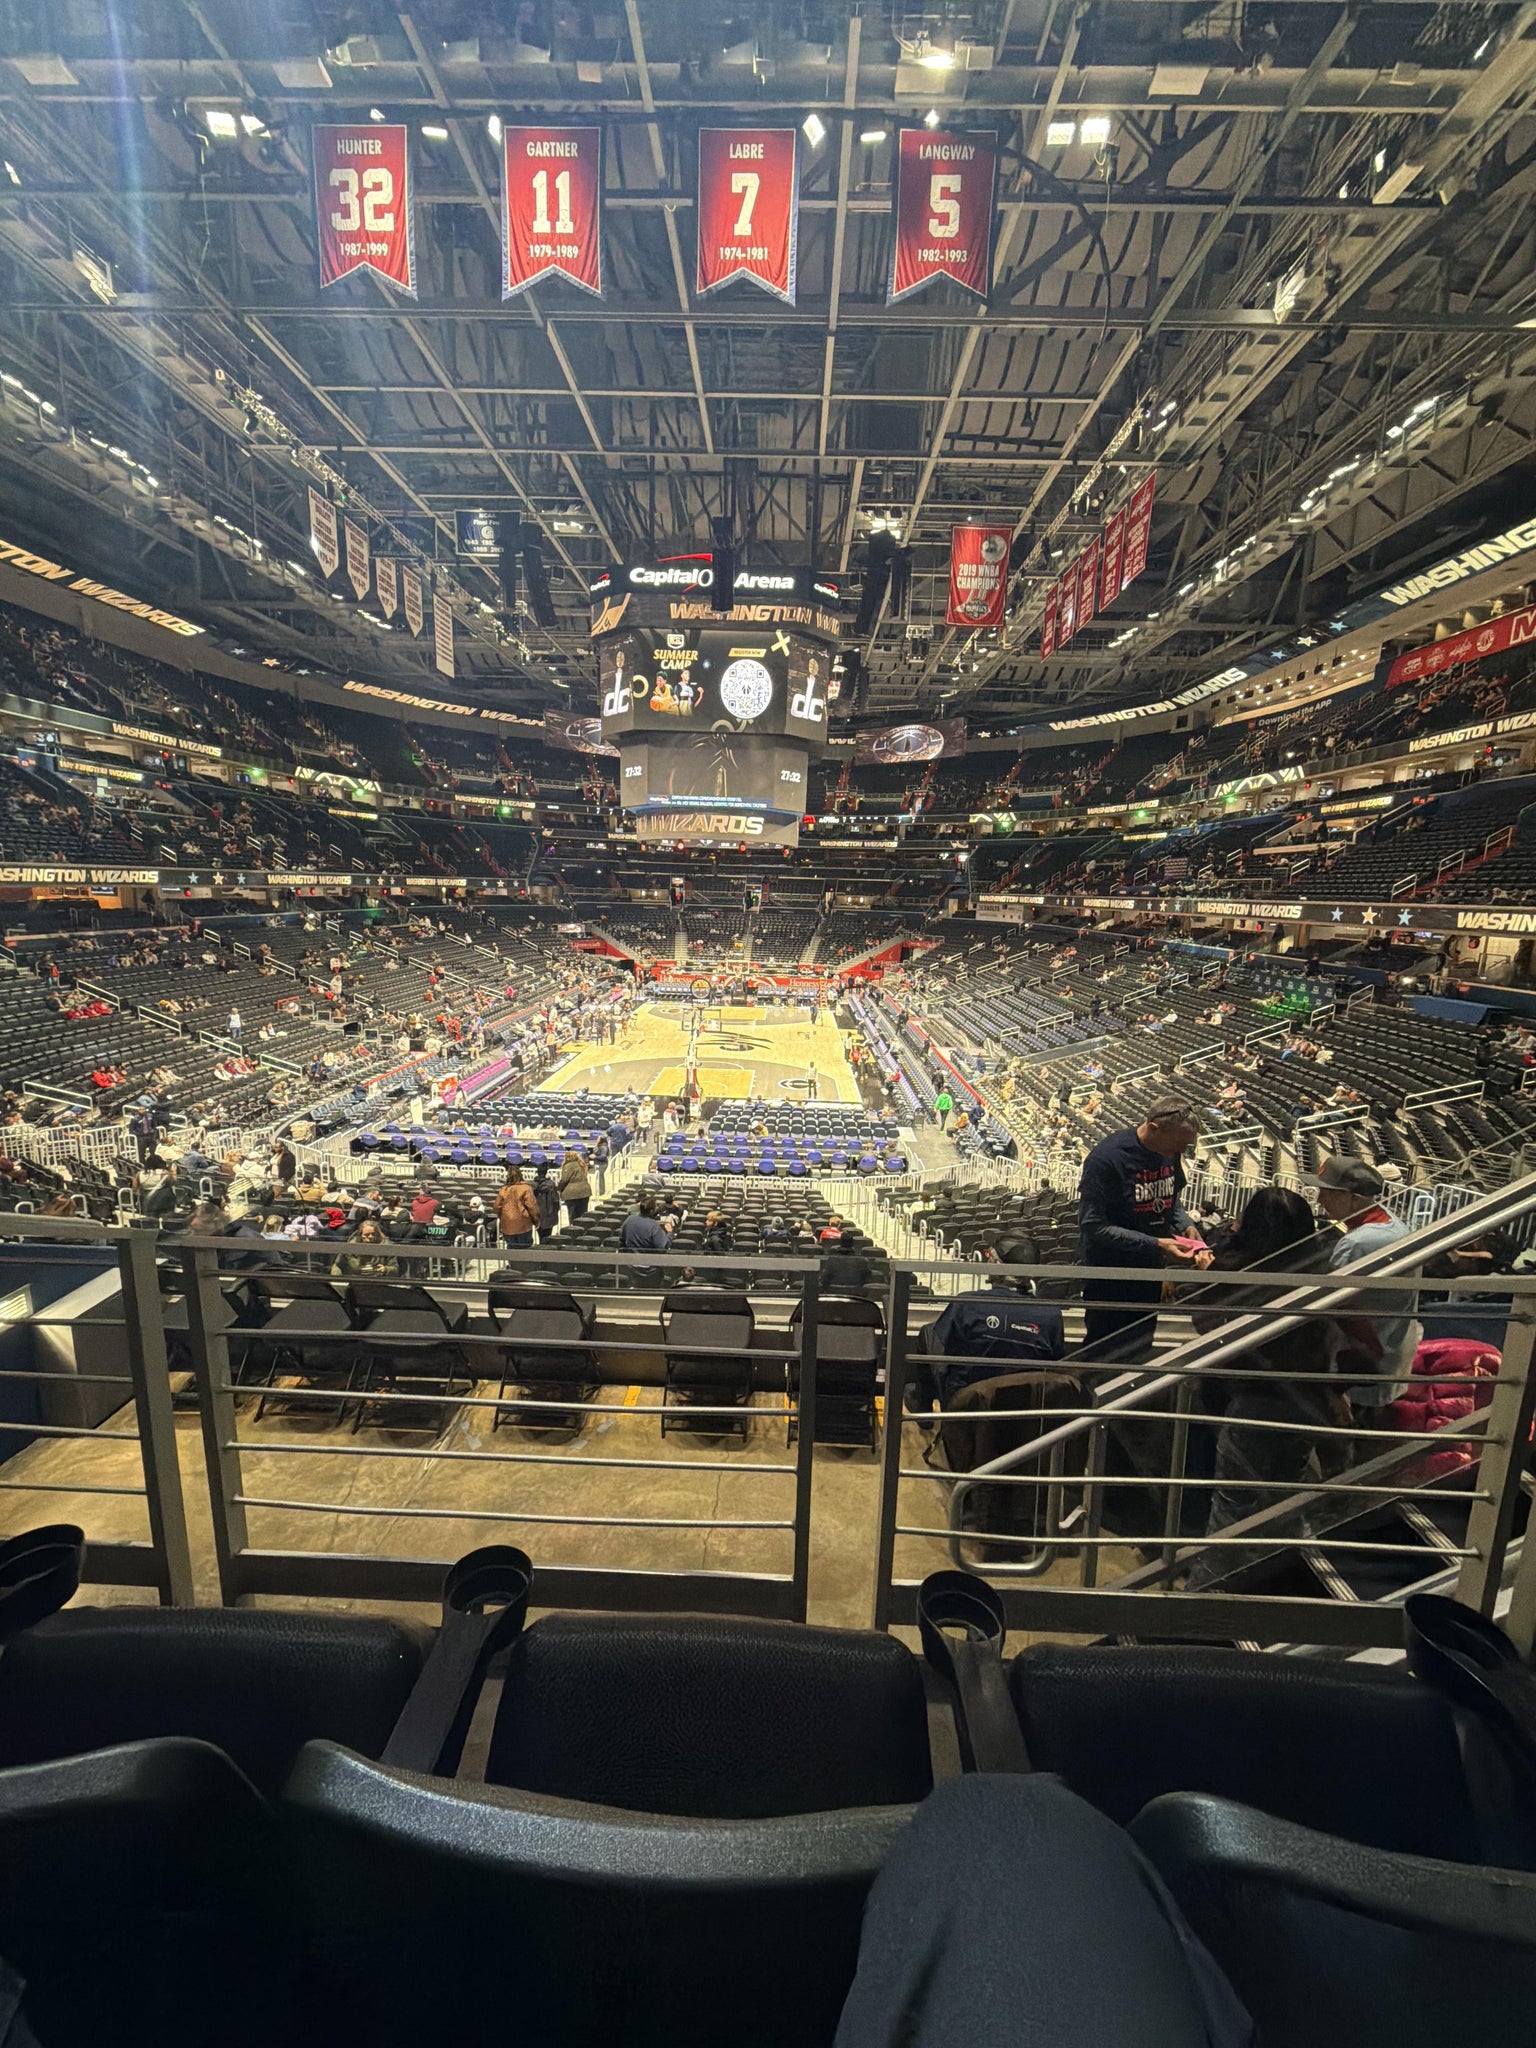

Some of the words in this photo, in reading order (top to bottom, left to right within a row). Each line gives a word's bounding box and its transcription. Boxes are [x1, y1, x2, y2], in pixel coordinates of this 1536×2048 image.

[337, 138, 382, 157] HUNTER
[526, 140, 579, 159] GARTNER
[728, 142, 765, 161] LABRE
[918, 143, 976, 161] LANGWAY
[329, 168, 394, 233] 32
[532, 170, 574, 235] 11
[731, 172, 760, 237] 7
[928, 174, 961, 238] 5
[339, 242, 389, 259] 1987-1999
[529, 243, 580, 261] 1979-1989
[719, 245, 769, 261] 1974-1981
[917, 247, 969, 264] 1982-1993
[958, 563, 977, 577] 2019
[978, 564, 1000, 577] WNBA
[1381, 518, 1536, 606] WASHING
[734, 572, 795, 590] Arena
[956, 576, 1001, 590] CHAMPIONS
[68, 577, 206, 636] WIZARDS
[670, 602, 812, 624] WASINGTON
[653, 648, 699, 661] SUMMER
[660, 659, 693, 670] CAMP
[342, 680, 478, 716] WASHINGTON
[479, 709, 547, 727] WIZAR
[1049, 700, 1177, 731] WASHINGTON
[1173, 667, 1248, 706] WIZARDS
[1258, 709, 1301, 727] Download
[1301, 706, 1314, 717] the
[112, 722, 177, 748] WASHINGTON
[178, 738, 222, 757] WIZARDS
[1409, 721, 1494, 753] WASHINGTON
[1496, 711, 1536, 734] WIZA
[780, 769, 801, 783] 27:32
[651, 814, 765, 836] WIZARDS
[0, 867, 87, 883] ASHINGTON
[91, 870, 160, 884] WIZARDS
[267, 874, 318, 885] WASHINGTON
[318, 875, 352, 886] WIZARDS
[1197, 902, 1250, 916] WASHINGTON
[1251, 904, 1303, 919] WIZARDS
[1457, 911, 1536, 933] WASHIN
[789, 978, 820, 987] Henness
[1135, 1176, 1175, 1202] DISTRIC
